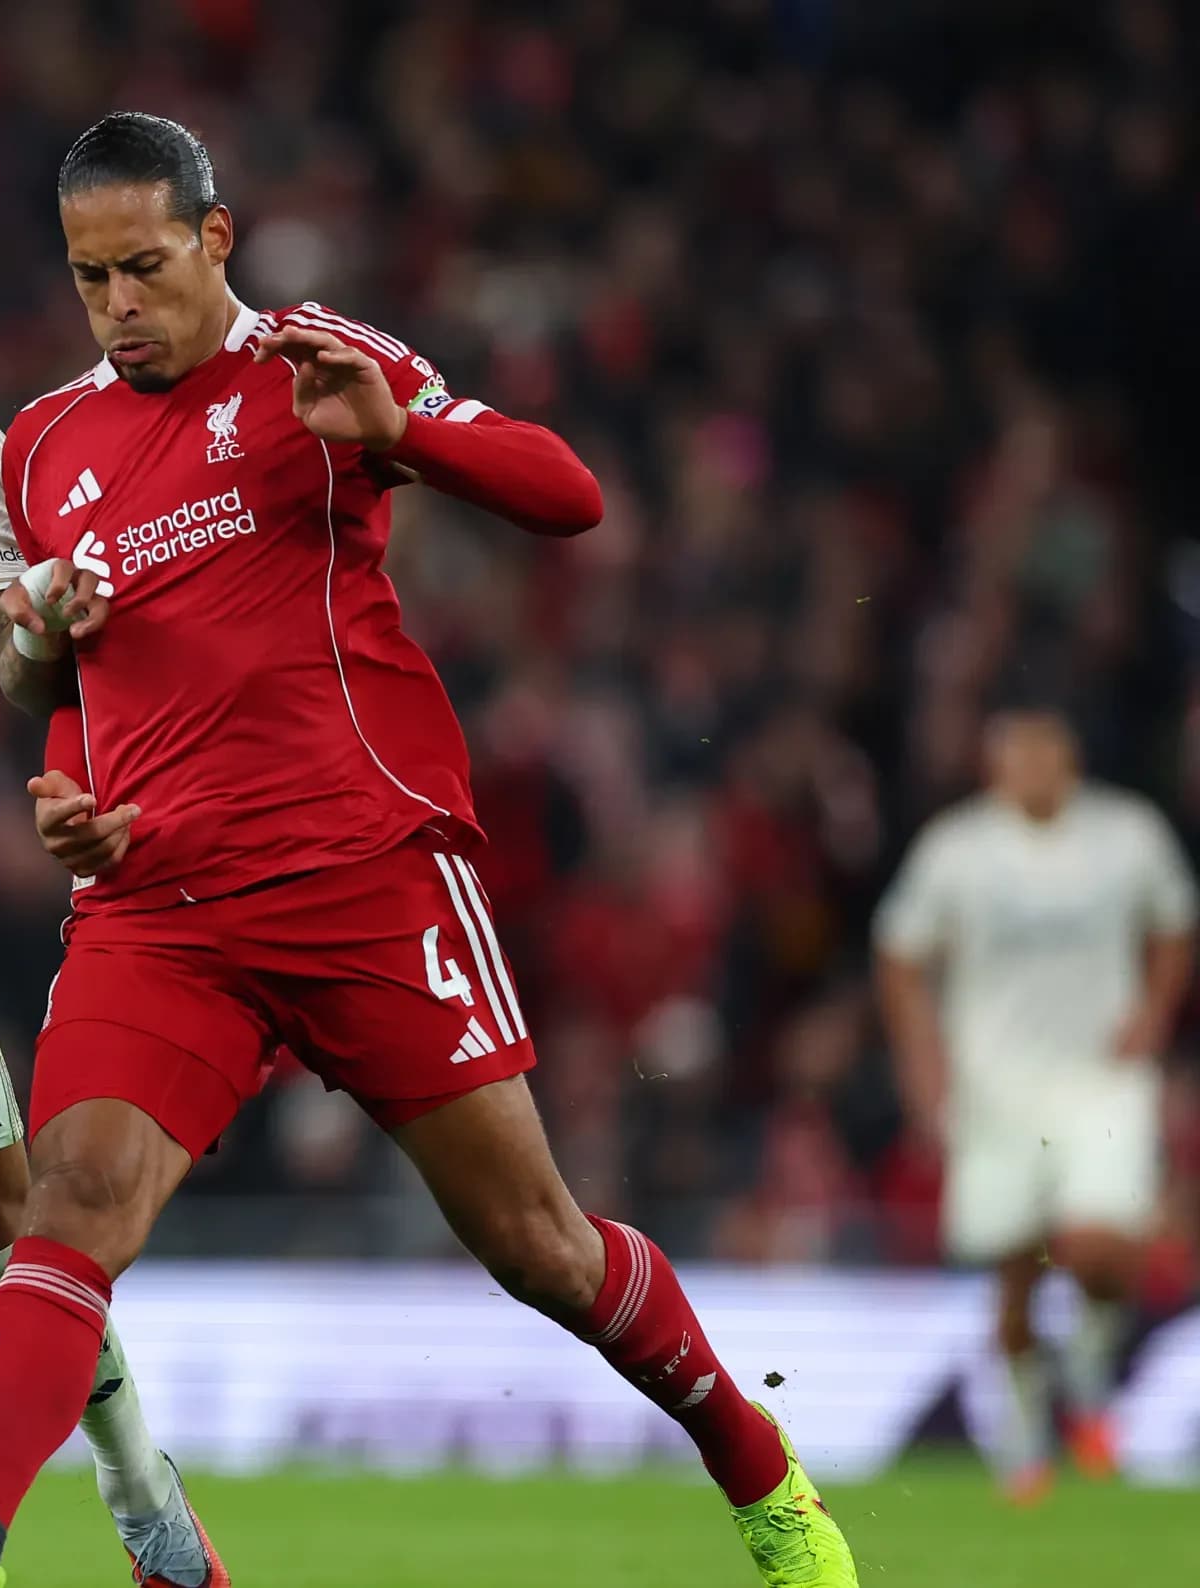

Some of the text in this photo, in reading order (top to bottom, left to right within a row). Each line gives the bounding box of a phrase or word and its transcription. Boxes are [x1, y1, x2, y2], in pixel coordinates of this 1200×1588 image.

[116, 486, 242, 554] standard
[121, 508, 257, 576] chartered
[422, 924, 475, 1007] 4
